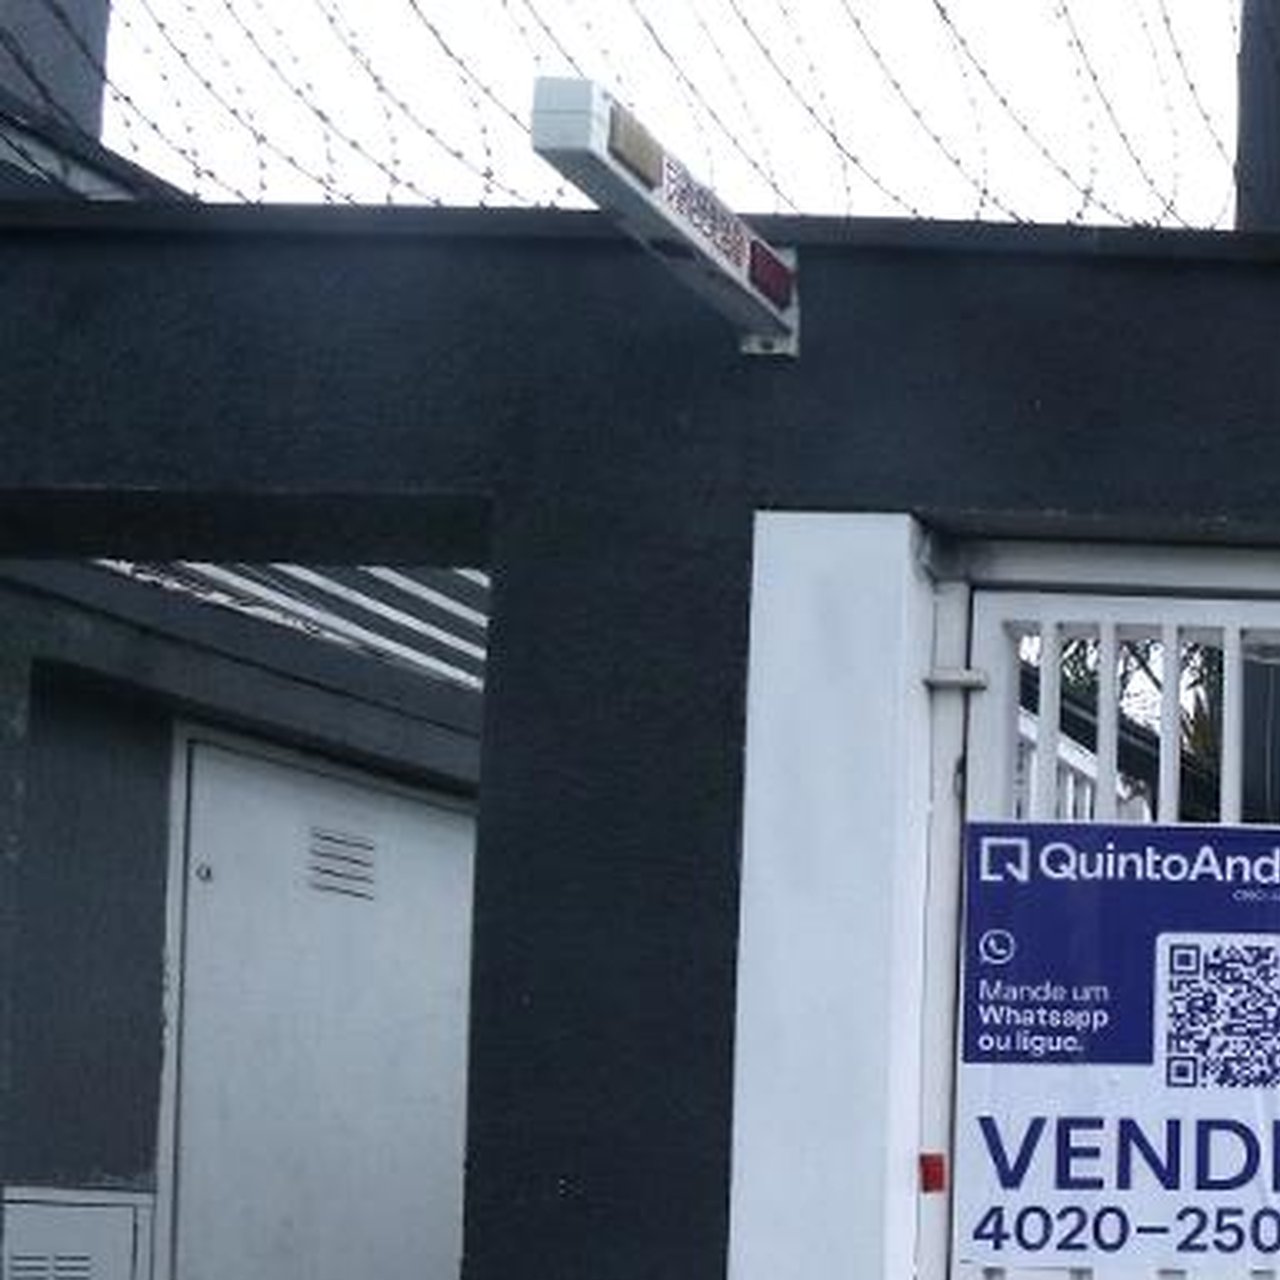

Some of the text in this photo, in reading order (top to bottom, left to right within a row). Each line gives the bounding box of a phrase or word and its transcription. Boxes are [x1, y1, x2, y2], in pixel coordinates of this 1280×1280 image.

[979, 979, 1109, 1001] Mande um
[979, 1034, 1011, 1051] ou
